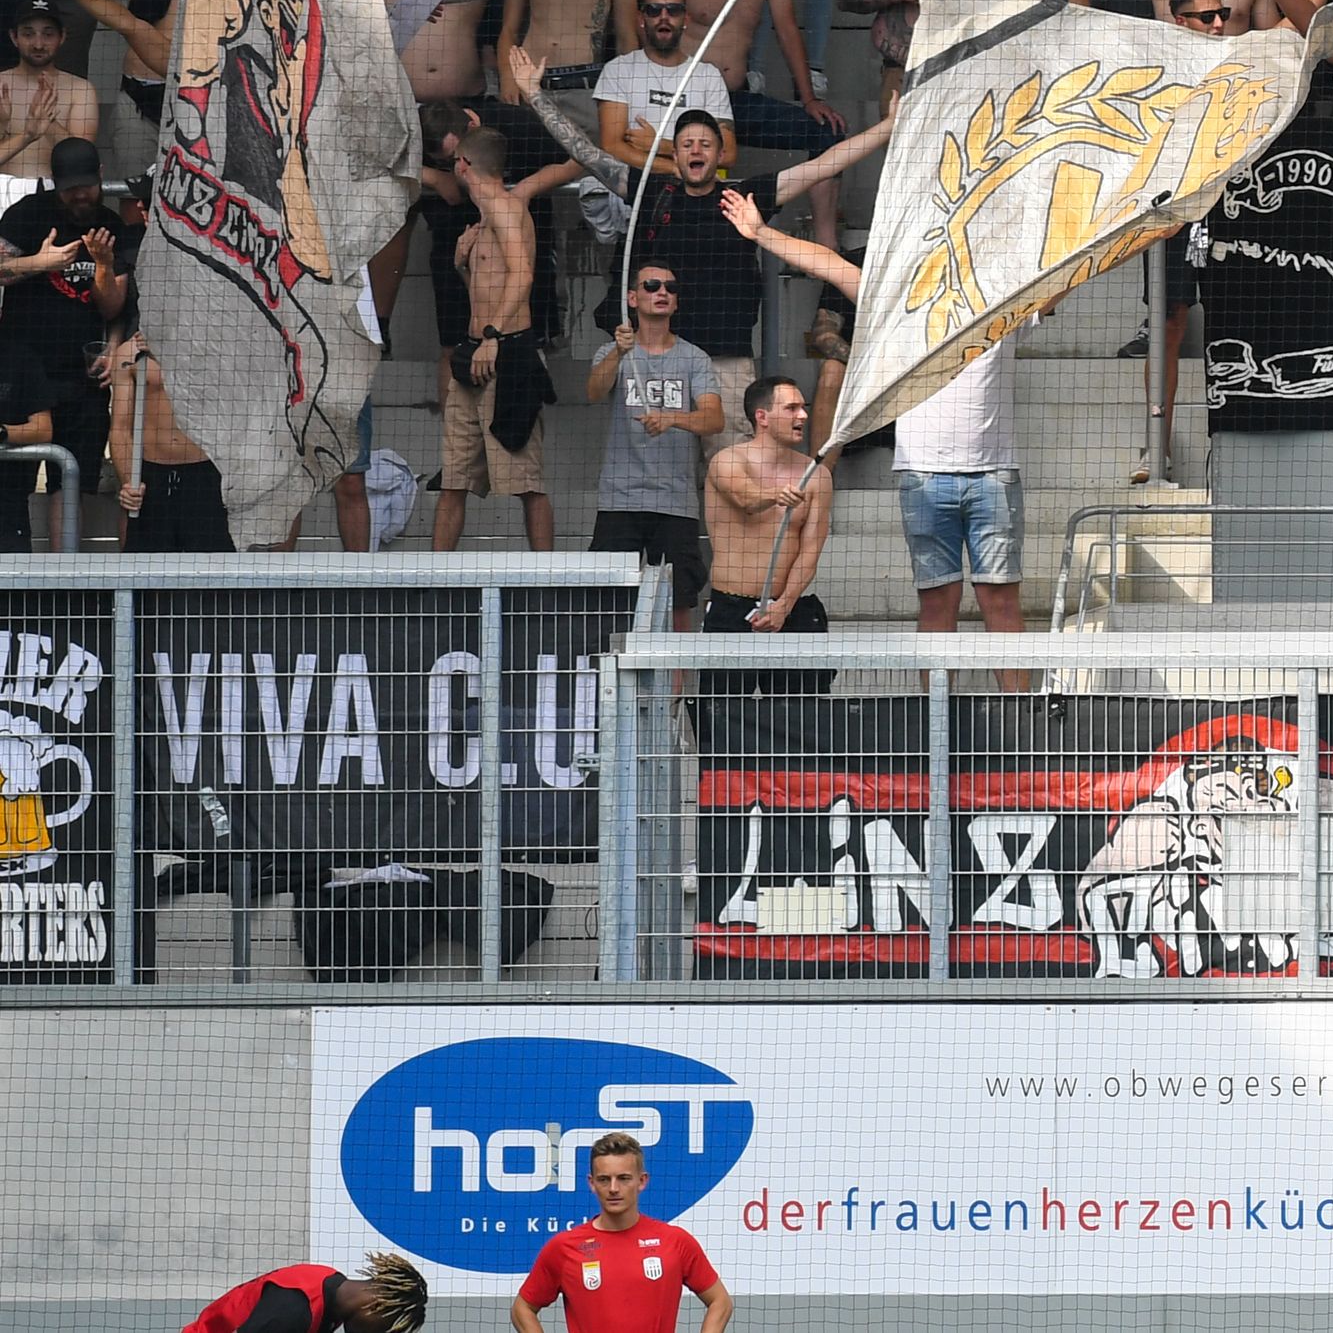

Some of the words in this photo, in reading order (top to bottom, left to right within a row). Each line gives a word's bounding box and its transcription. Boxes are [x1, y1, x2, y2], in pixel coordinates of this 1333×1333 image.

[1276, 158, 1332, 187] 1990
[625, 377, 685, 409] LCG
[152, 652, 385, 785] VIVA
[461, 1217, 507, 1233] Die
[527, 1213, 588, 1233] Küc
